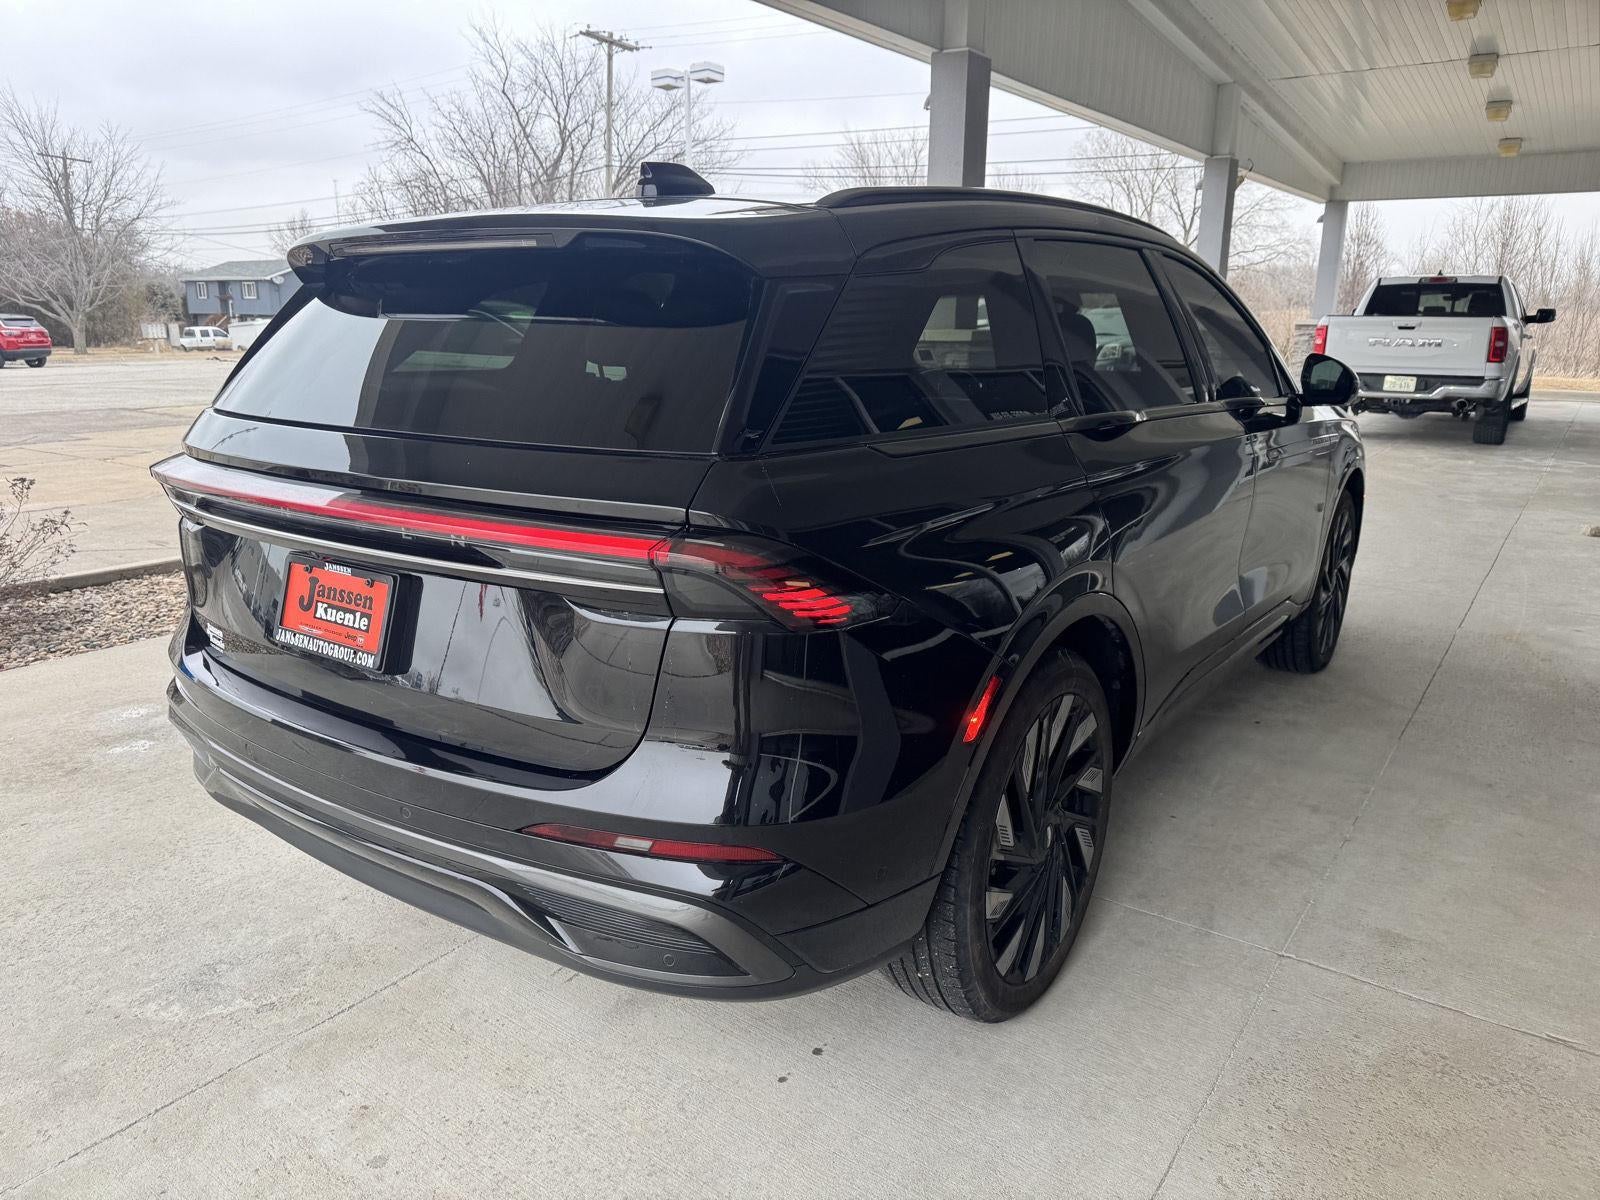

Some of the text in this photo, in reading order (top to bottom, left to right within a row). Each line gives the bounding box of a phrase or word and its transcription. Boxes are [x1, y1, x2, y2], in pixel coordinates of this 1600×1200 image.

[1368, 337, 1443, 347] RAM
[324, 562, 352, 575] JANSSEN
[299, 576, 374, 611] Janssen
[315, 602, 369, 630] Kuenle
